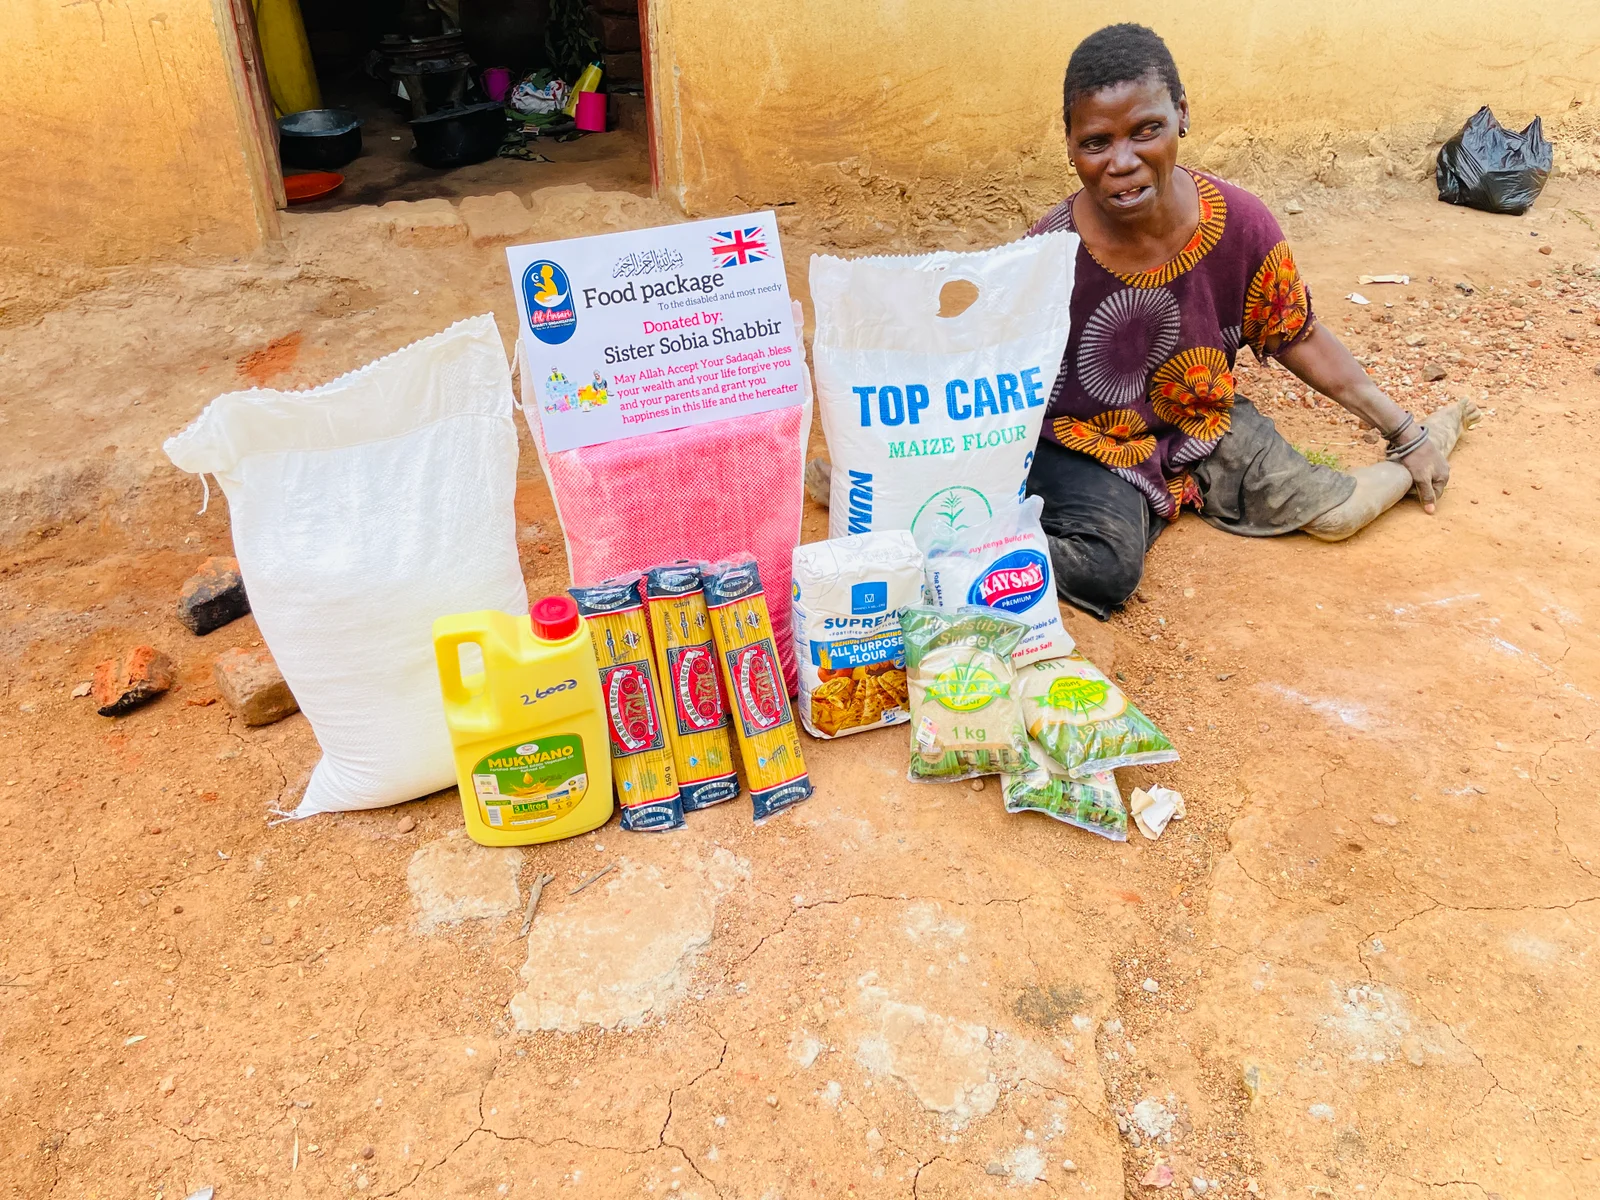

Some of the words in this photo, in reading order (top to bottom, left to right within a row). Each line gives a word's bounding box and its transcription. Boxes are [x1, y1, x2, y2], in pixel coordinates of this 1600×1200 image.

[582, 281, 637, 309] Food
[640, 273, 724, 303] package
[658, 302, 669, 311] To
[670, 299, 684, 308] the
[685, 294, 718, 306] disabled
[719, 291, 735, 301] and
[736, 288, 756, 299] most
[757, 283, 782, 296] needy
[643, 313, 700, 334] Donated
[702, 311, 724, 325] by:
[604, 343, 655, 365] Sister
[659, 333, 709, 355] Sobia
[712, 320, 782, 344] Shabbir
[614, 374, 636, 387] May
[638, 367, 665, 381] Allah
[667, 361, 699, 376] Accept
[700, 358, 724, 370] Your
[726, 350, 765, 365] Sadaqah
[617, 387, 640, 400] your
[642, 380, 676, 394] wealth
[677, 375, 695, 387] and
[696, 373, 719, 386] your
[720, 366, 737, 380] life
[738, 361, 771, 376] forgive
[773, 358, 791, 371] you
[619, 398, 638, 411] and
[640, 397, 662, 409] your
[664, 388, 700, 404] parents
[702, 382, 720, 395] and
[721, 380, 746, 393] grant
[748, 376, 767, 388] you
[622, 408, 670, 424] happiness
[671, 405, 682, 416] in
[682, 399, 700, 413] this
[702, 395, 718, 409] life
[719, 393, 737, 406] and
[738, 390, 754, 403] the
[755, 383, 799, 399] hereafter
[852, 384, 930, 427] TOP
[946, 366, 1045, 421] CARE
[888, 437, 956, 459] MAIZE
[962, 425, 1027, 452] FLOUR
[848, 469, 873, 536] NUM
[979, 561, 1044, 600] KAYSALT
[1001, 594, 1032, 608] PREMIUM
[923, 617, 1014, 635] Irresistibly
[1048, 617, 1058, 625] Salt
[829, 646, 851, 658] ALL
[852, 637, 904, 654] PURPOSE
[937, 632, 997, 649] Sweet
[1025, 647, 1039, 655] Sea
[1040, 641, 1053, 650] Salt
[849, 649, 887, 665] FLOUR
[681, 657, 693, 688] LUCIA
[742, 658, 750, 689] LUCIA
[520, 679, 578, 705] 26000
[610, 677, 620, 709] LUCIA
[928, 682, 1002, 697] KINYARA
[951, 697, 980, 706] Sugar
[682, 693, 701, 723] SANTA
[744, 693, 764, 723] SANTA
[612, 713, 632, 745] SANTA
[952, 726, 959, 740] 1
[965, 726, 987, 742] kg
[1078, 719, 1129, 740] Sweet
[488, 745, 574, 768] MUKWANO
[522, 802, 547, 811] Litres
